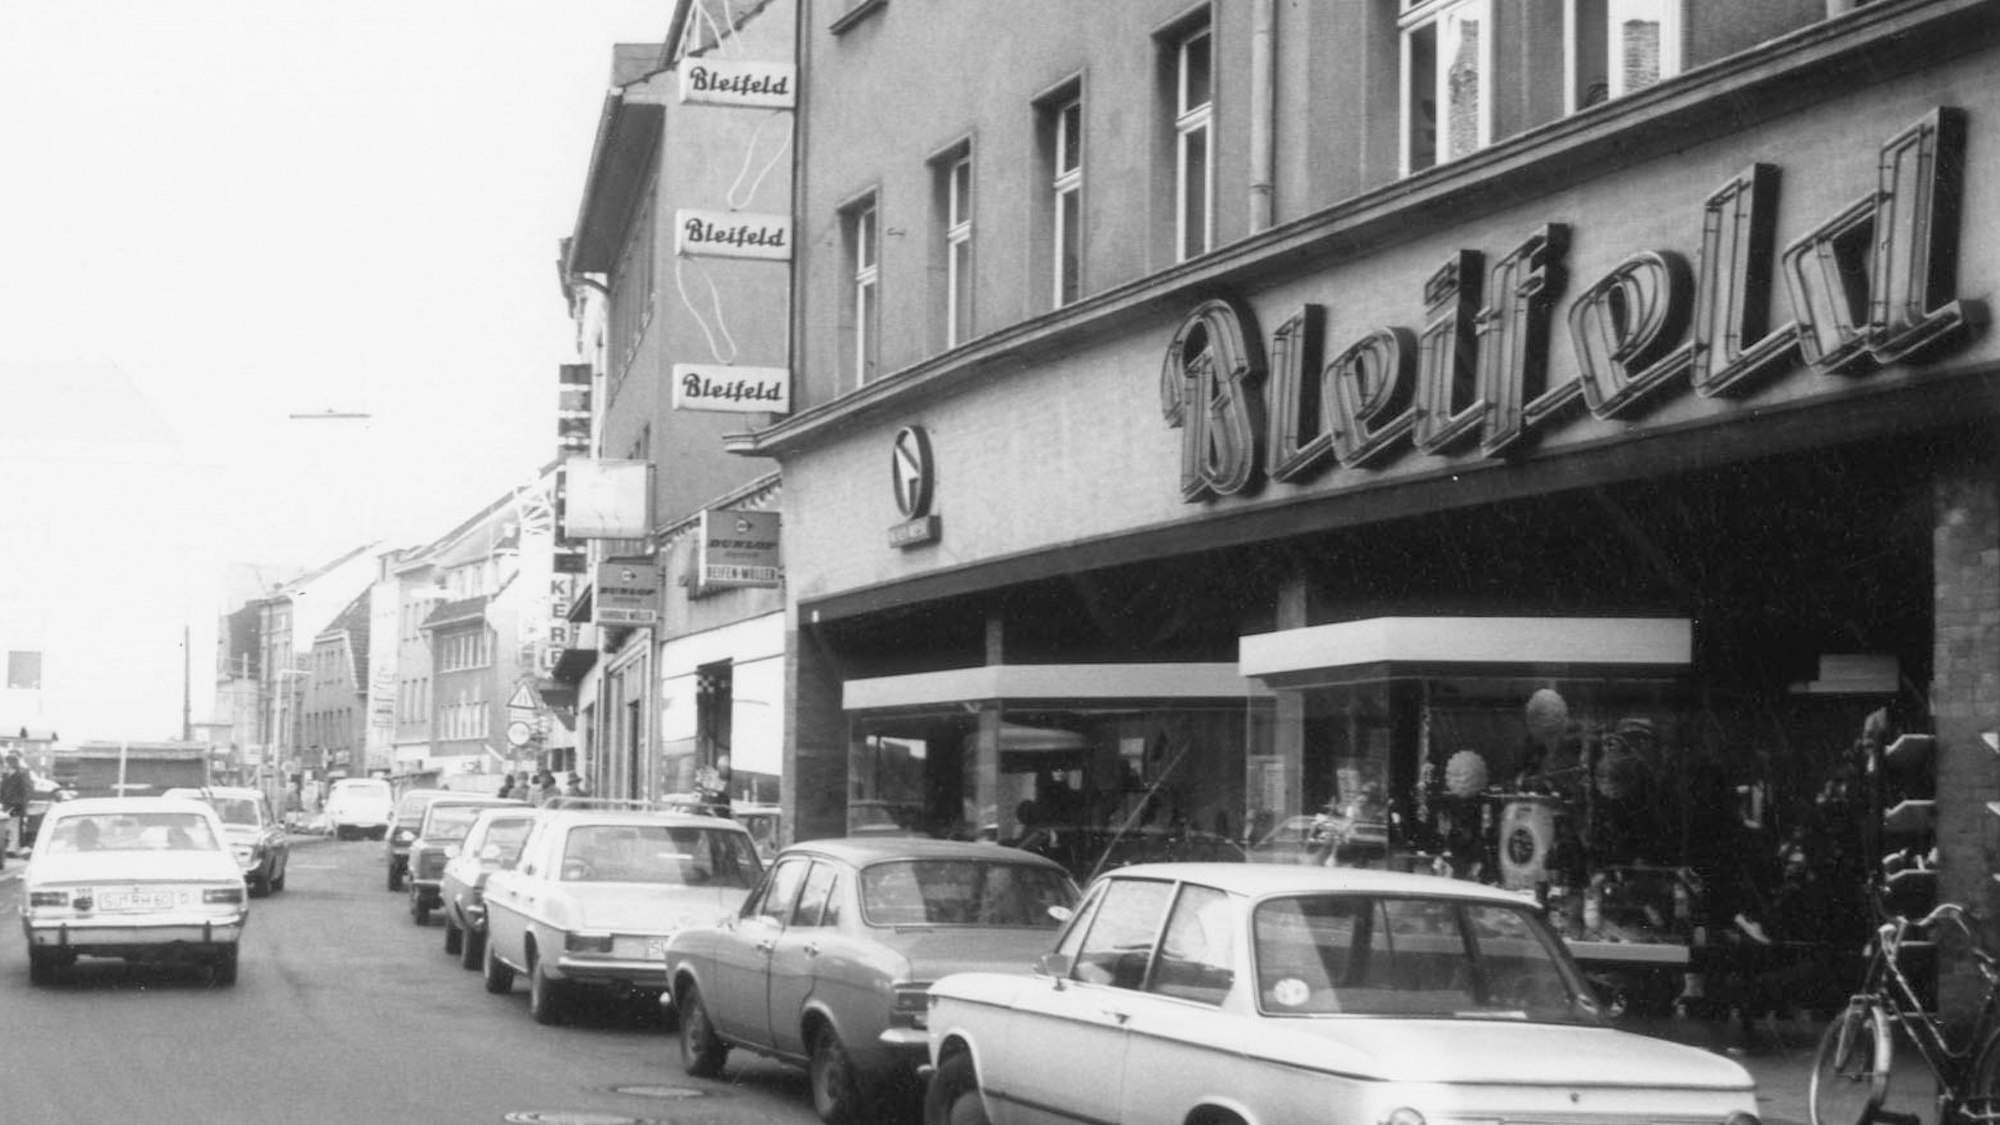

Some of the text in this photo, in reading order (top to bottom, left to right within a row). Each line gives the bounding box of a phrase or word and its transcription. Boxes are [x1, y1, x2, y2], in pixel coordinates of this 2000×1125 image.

[690, 66, 789, 95] Bleifeld
[685, 218, 786, 247] Bleifeld
[1159, 106, 1970, 504] Bleifeld
[682, 373, 782, 402] Bleifeld
[708, 539, 778, 550] DUNLOP
